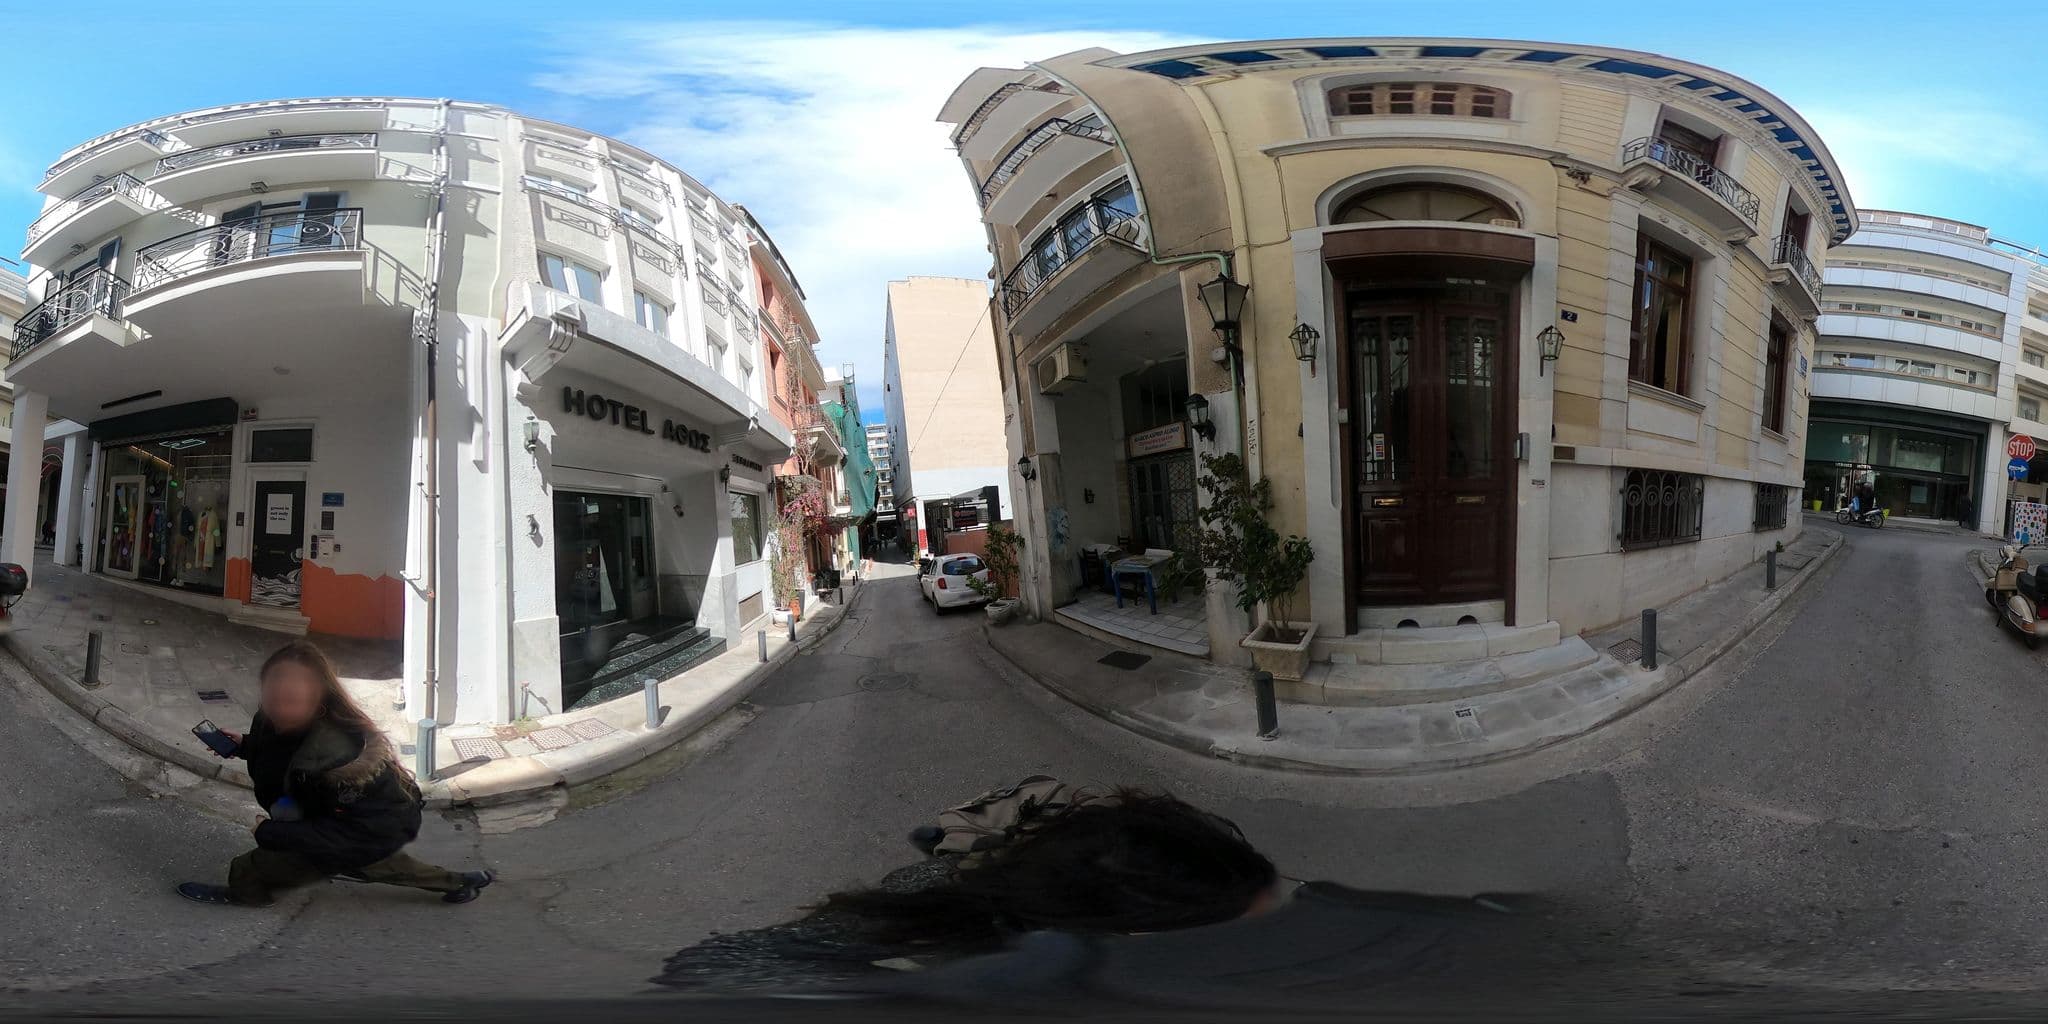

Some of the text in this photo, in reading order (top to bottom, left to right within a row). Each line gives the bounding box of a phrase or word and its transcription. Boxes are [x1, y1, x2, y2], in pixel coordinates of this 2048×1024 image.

[1567, 312, 1574, 321] 2
[563, 385, 655, 435] HOTEL
[2009, 440, 2034, 457] STOP
